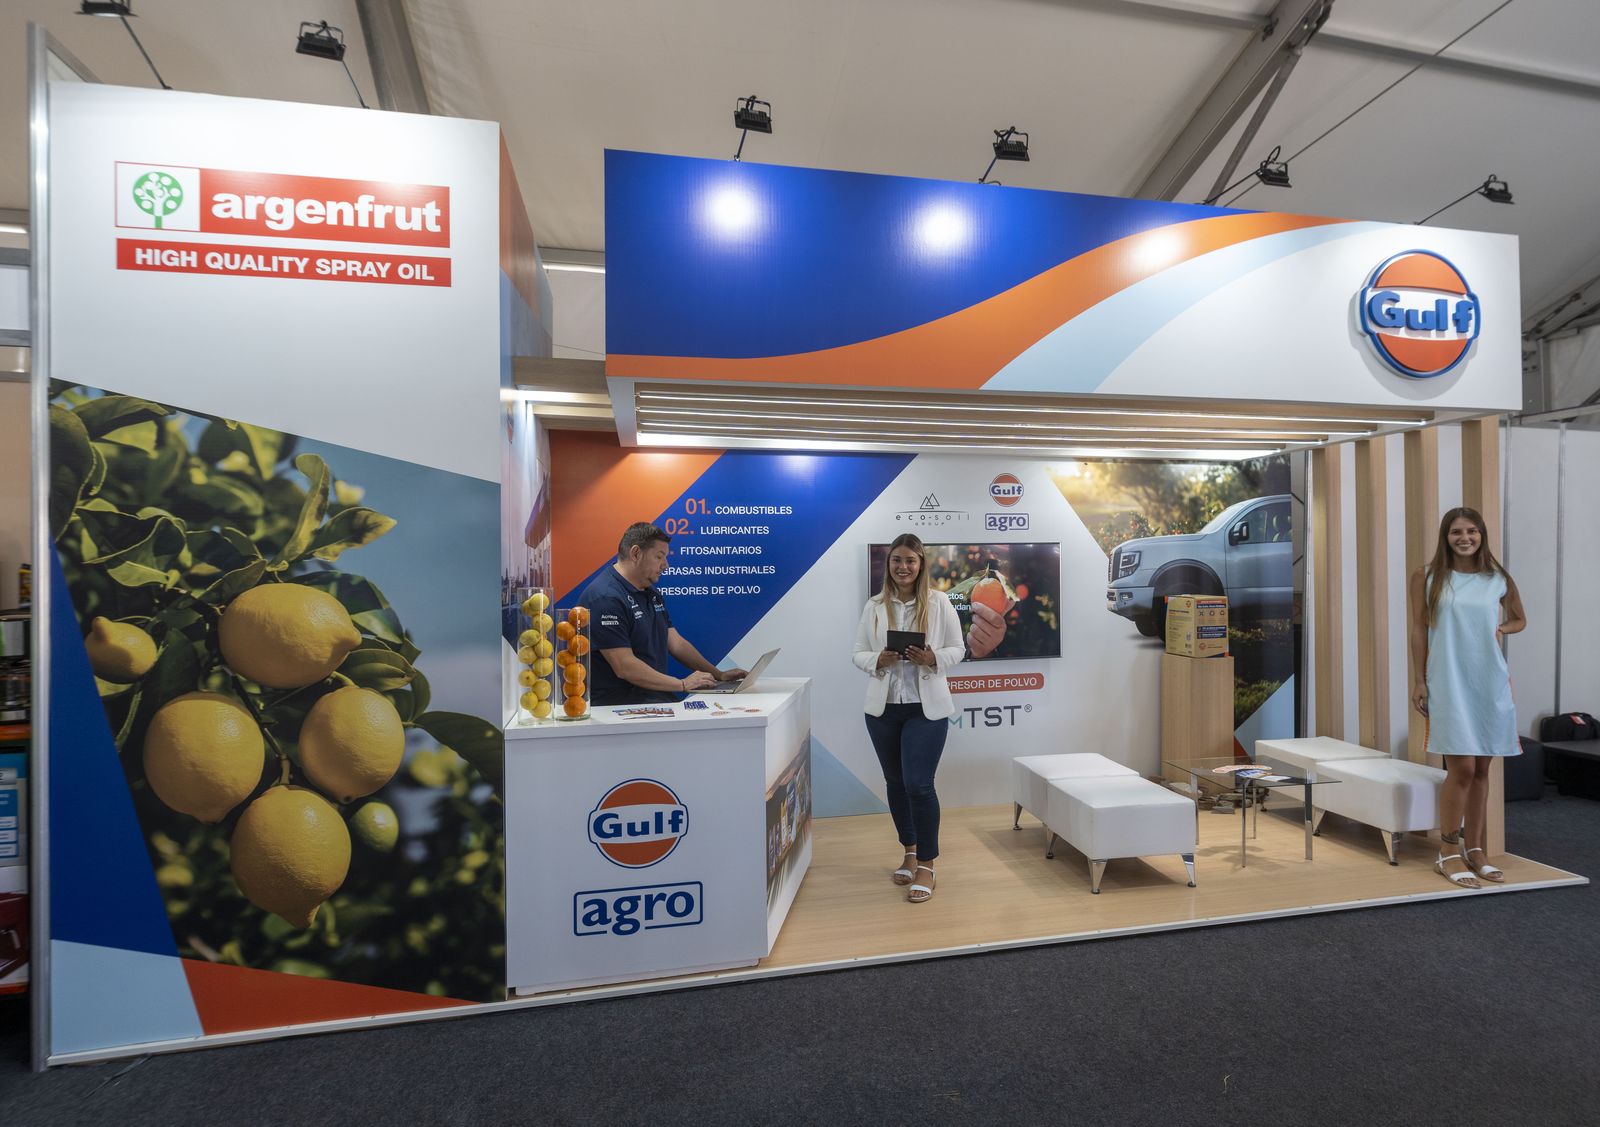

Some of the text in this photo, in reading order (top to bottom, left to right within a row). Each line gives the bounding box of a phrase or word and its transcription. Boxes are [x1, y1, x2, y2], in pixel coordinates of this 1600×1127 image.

[212, 192, 442, 233] argenfrut
[135, 247, 435, 281] HIGH QUALITY SPRAY OIL
[1368, 291, 1474, 333] Gulf
[991, 485, 1023, 496] Gulf
[685, 498, 793, 515] 01. COMBUSTIBLES
[665, 518, 770, 535] 02. LUBRICANTES
[988, 516, 1026, 531] agro
[680, 546, 762, 555] FITOSANITARIOS
[704, 566, 776, 575] INDUSTRIALES
[711, 586, 725, 595] DE
[727, 585, 761, 595] POLVO
[988, 679, 1002, 688] DE
[1004, 677, 1037, 687] POLVO
[593, 810, 684, 839] Gulf
[582, 891, 695, 936] agro
